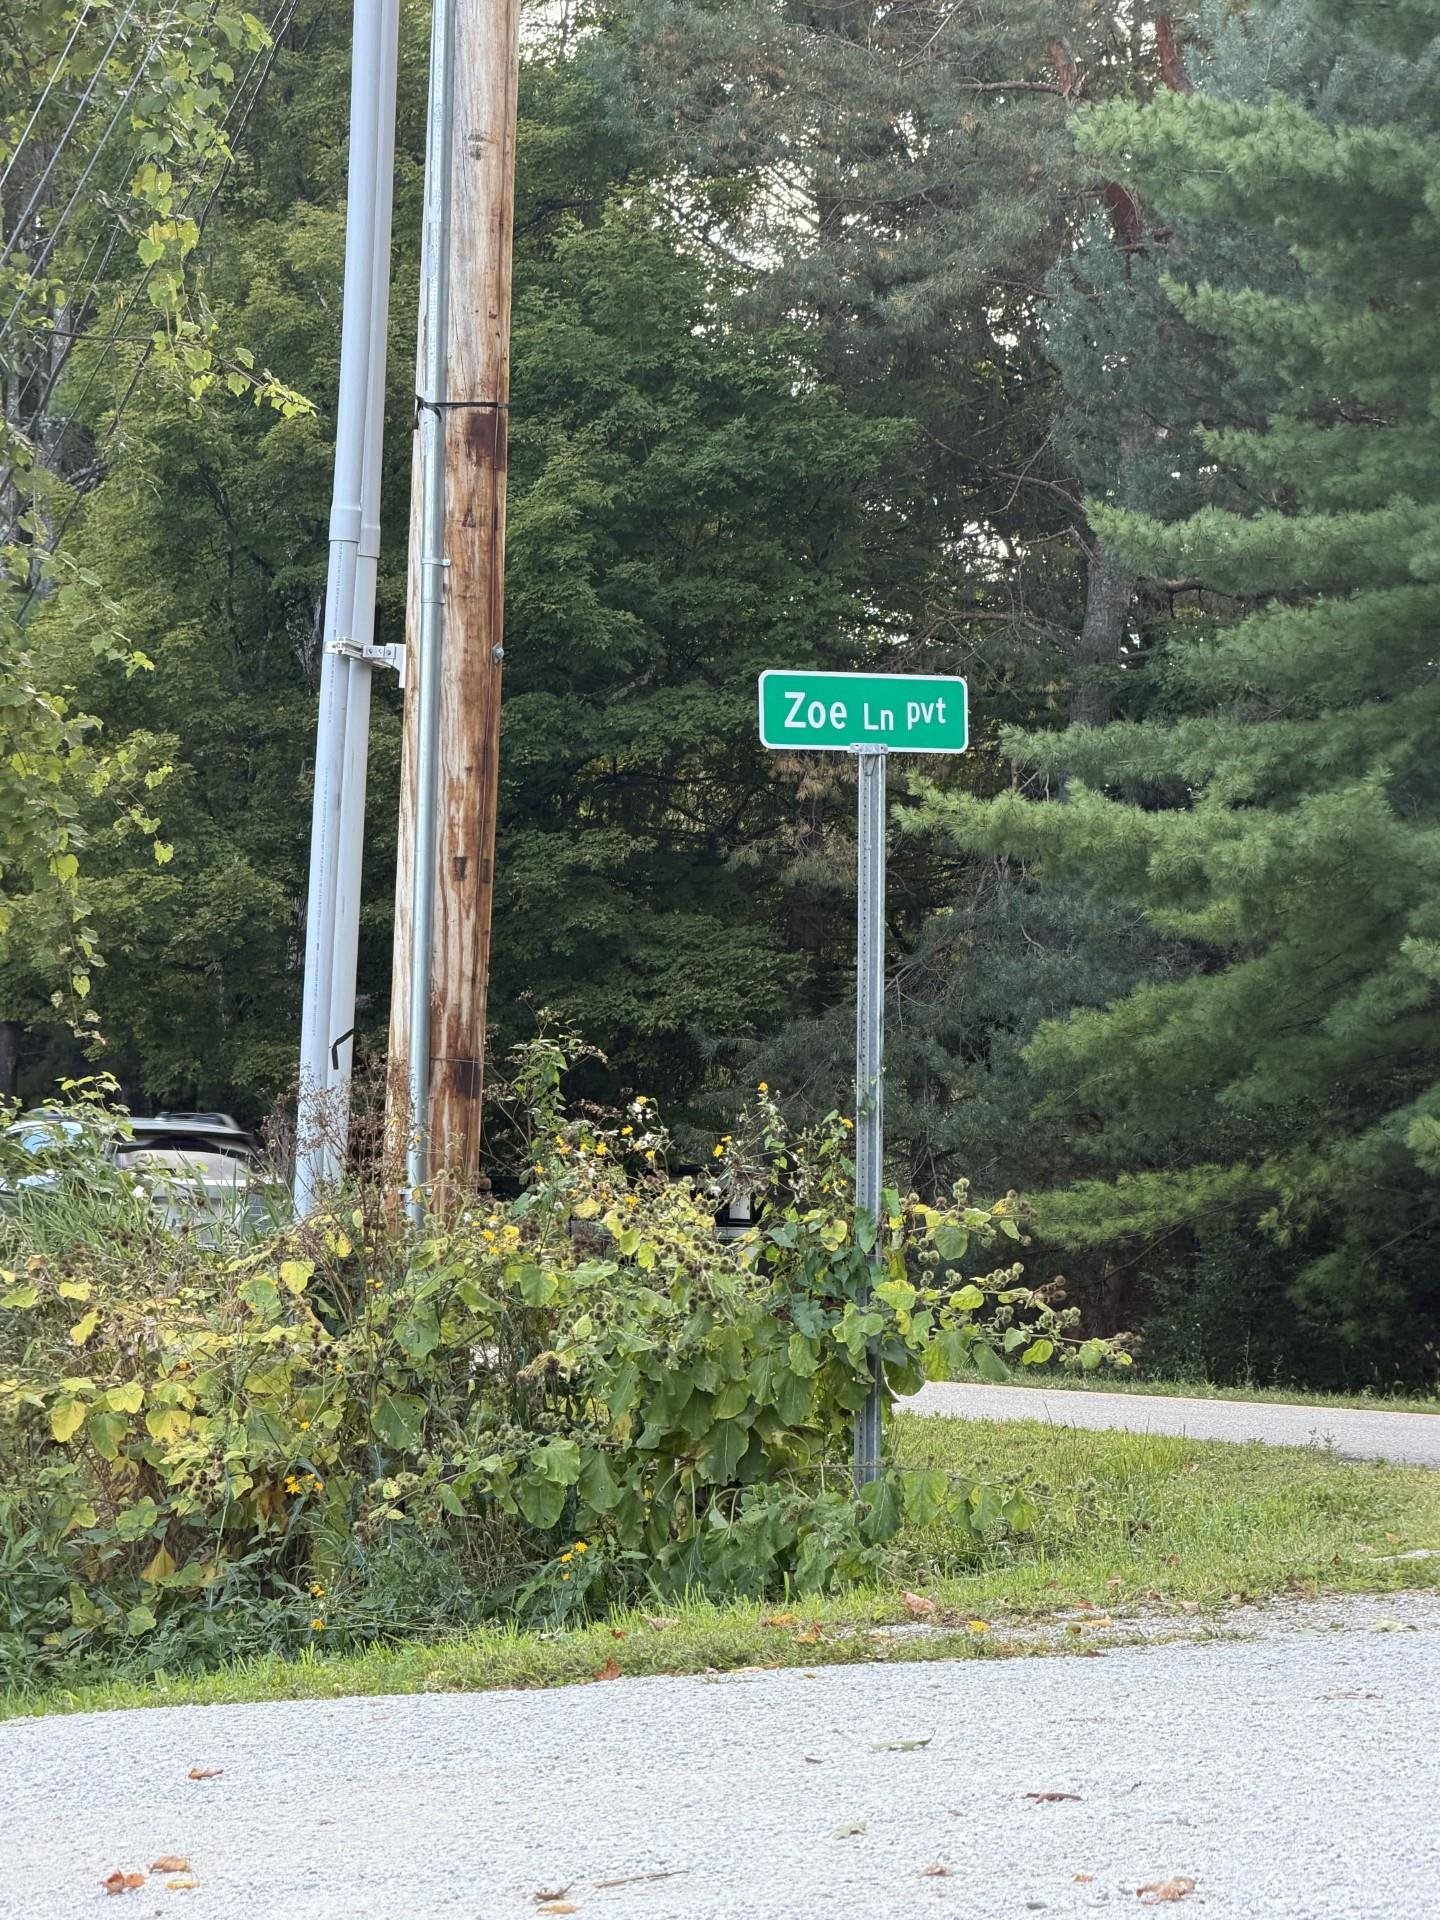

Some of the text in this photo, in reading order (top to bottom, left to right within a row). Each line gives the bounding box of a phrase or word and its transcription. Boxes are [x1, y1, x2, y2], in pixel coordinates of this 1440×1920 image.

[784, 691, 946, 731] Zoe Ln pvt
